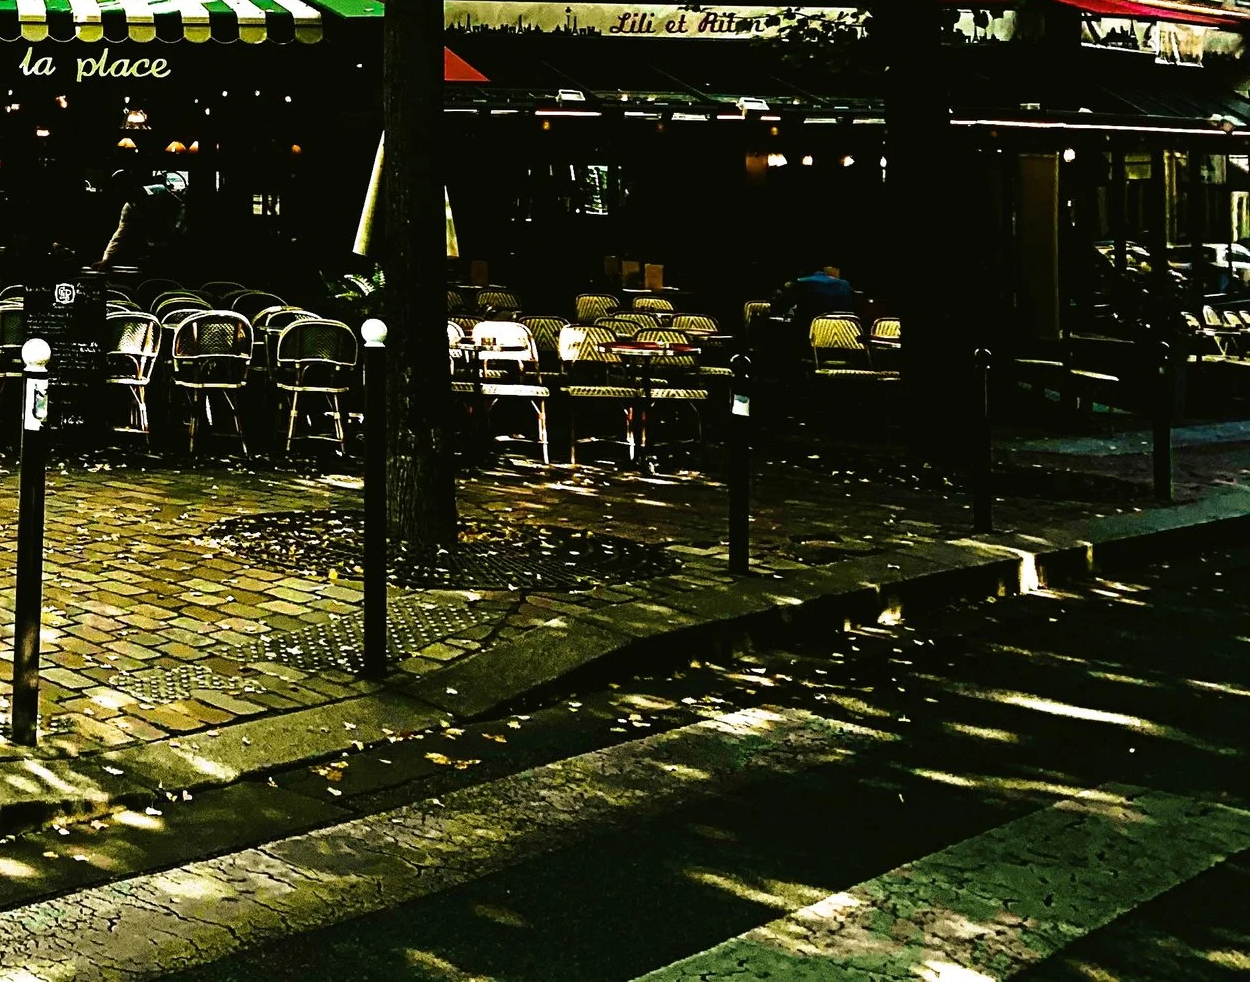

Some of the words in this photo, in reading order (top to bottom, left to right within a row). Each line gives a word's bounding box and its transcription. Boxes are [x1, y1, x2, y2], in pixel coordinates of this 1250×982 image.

[609, 11, 656, 34] Lili
[665, 14, 688, 34] et
[698, 12, 765, 34] Ritn
[19, 47, 56, 75] la
[75, 47, 171, 82] place
